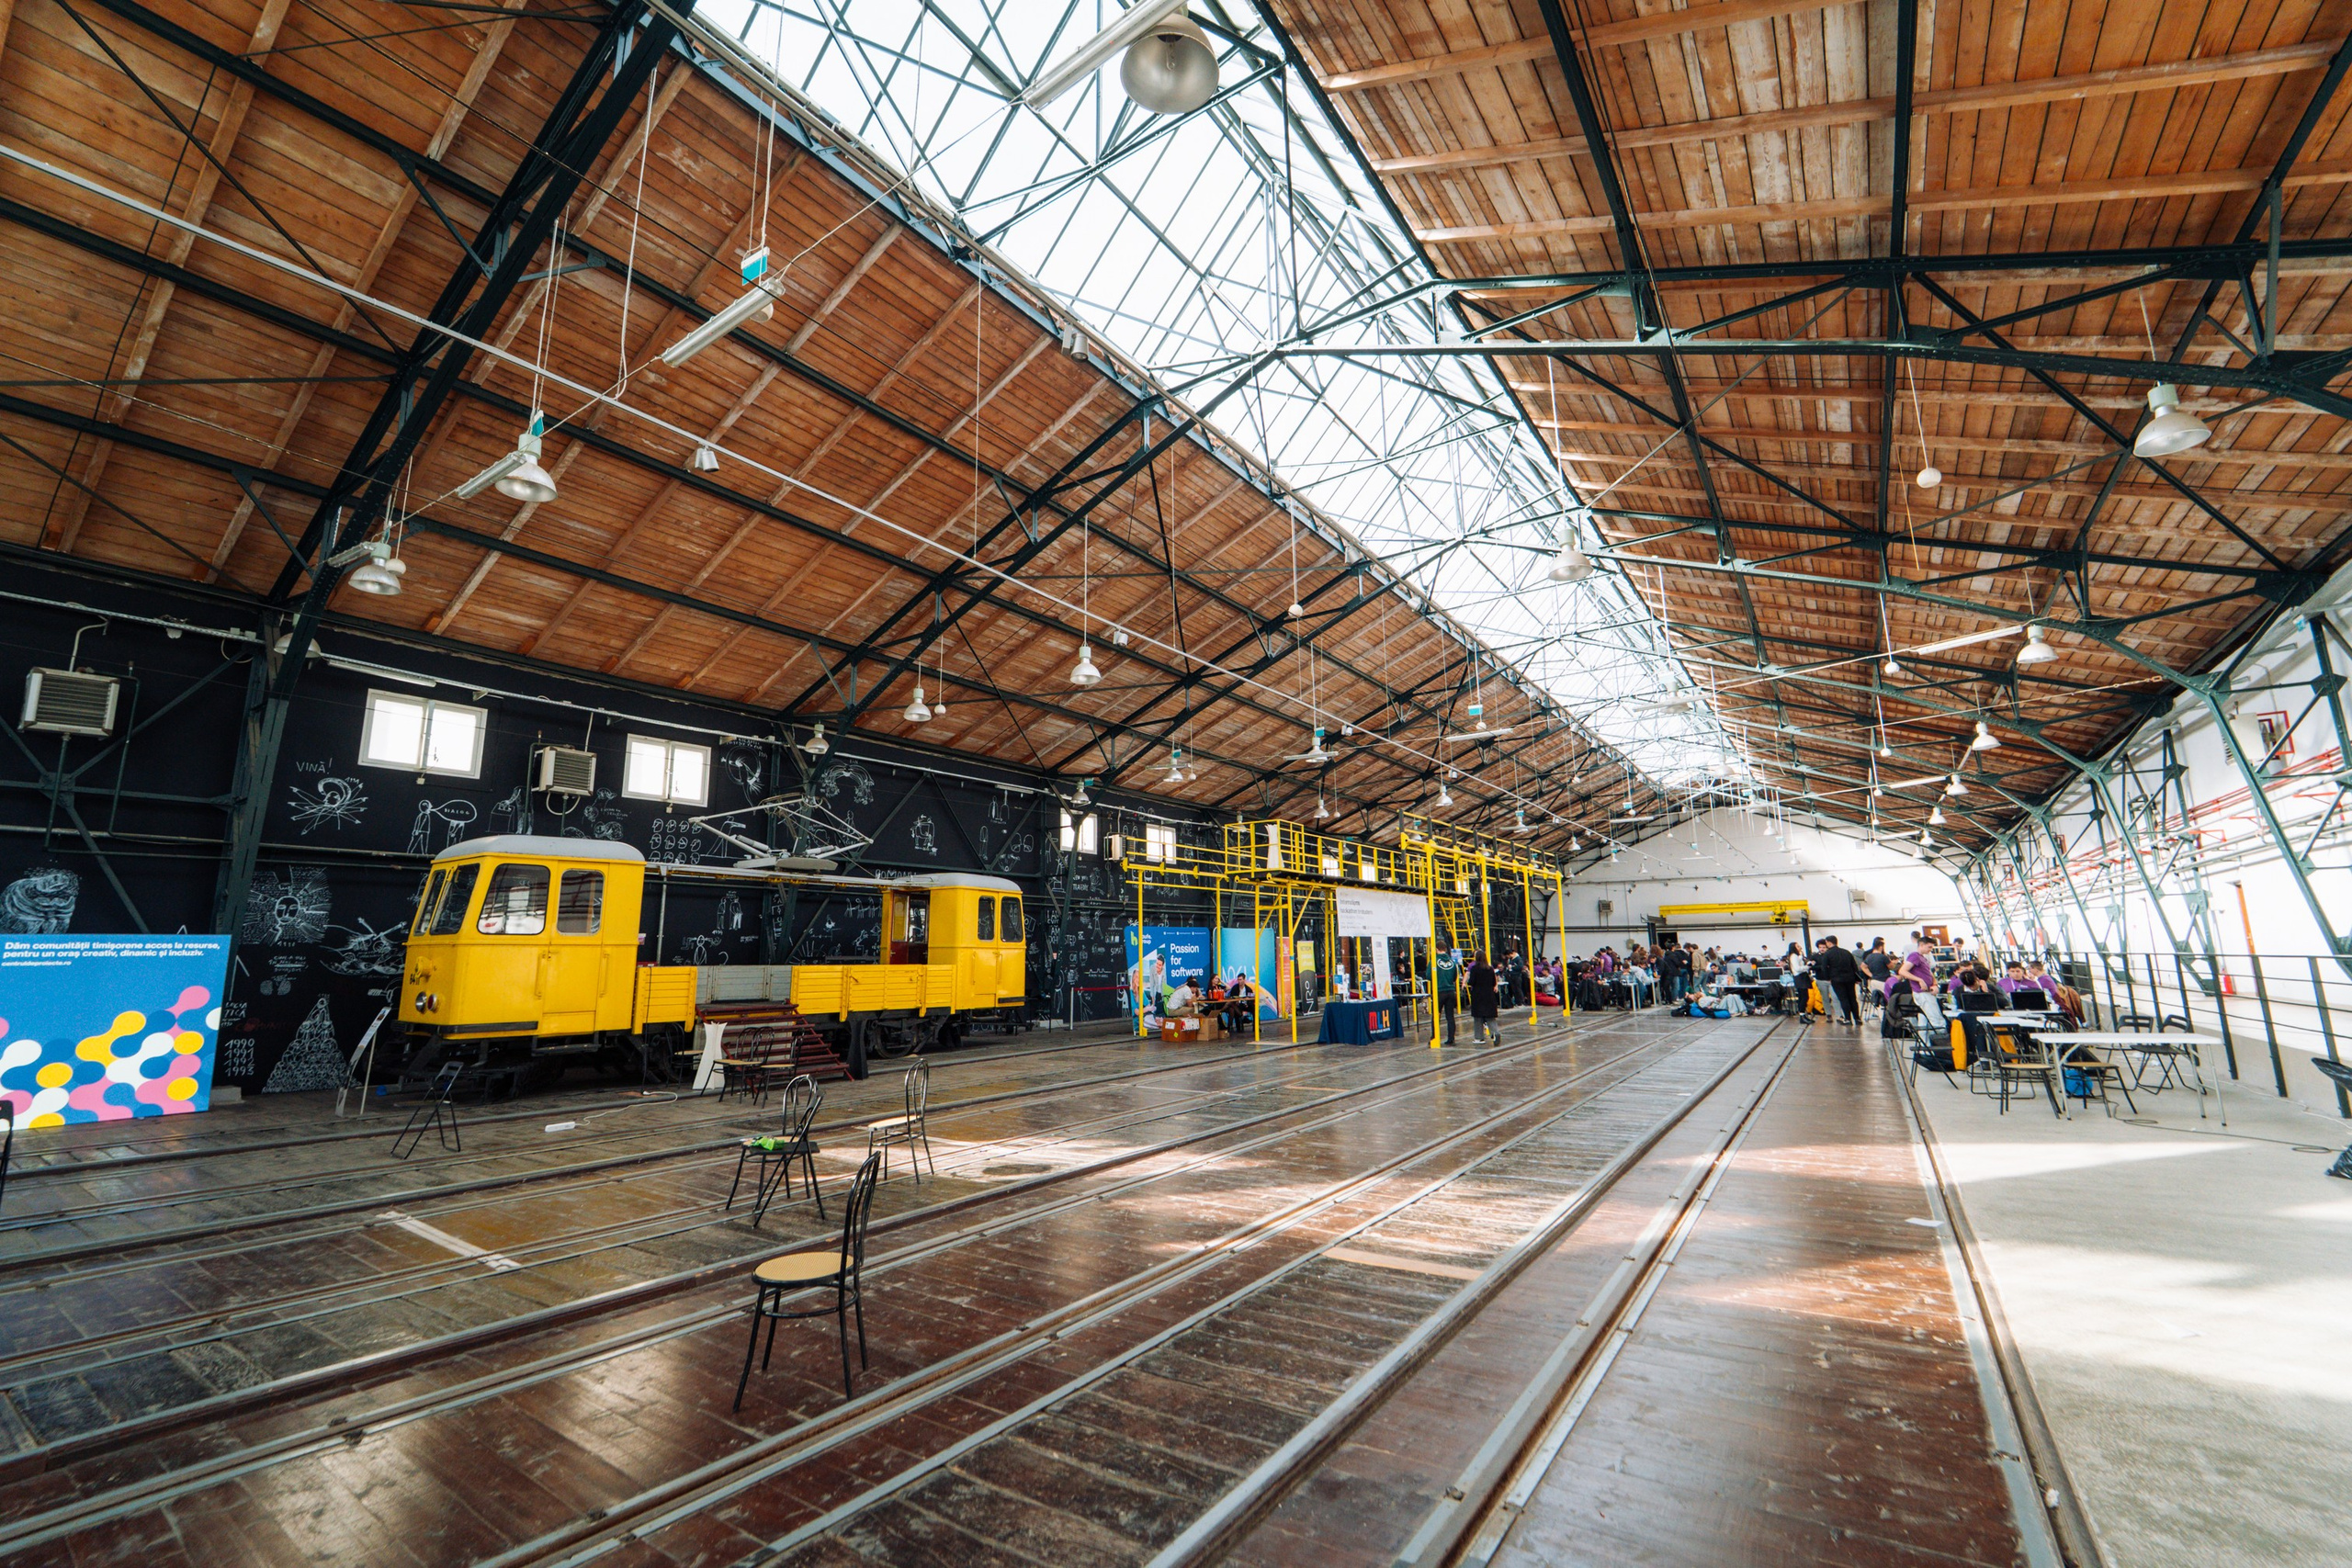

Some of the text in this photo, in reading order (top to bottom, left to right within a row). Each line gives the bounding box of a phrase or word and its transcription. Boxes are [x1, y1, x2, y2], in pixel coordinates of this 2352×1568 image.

[5, 942, 30, 950] Dăm
[1170, 942, 1200, 953] Passion
[3, 950, 40, 959] pentru
[82, 950, 119, 958] creativ,
[1170, 954, 1182, 965] for
[1170, 966, 1204, 977] software
[1369, 1010, 1390, 1031] MLH
[224, 1038, 255, 1049] 1990
[224, 1047, 254, 1056] 1991
[223, 1057, 255, 1066] 1992
[224, 1066, 254, 1077] 1993
